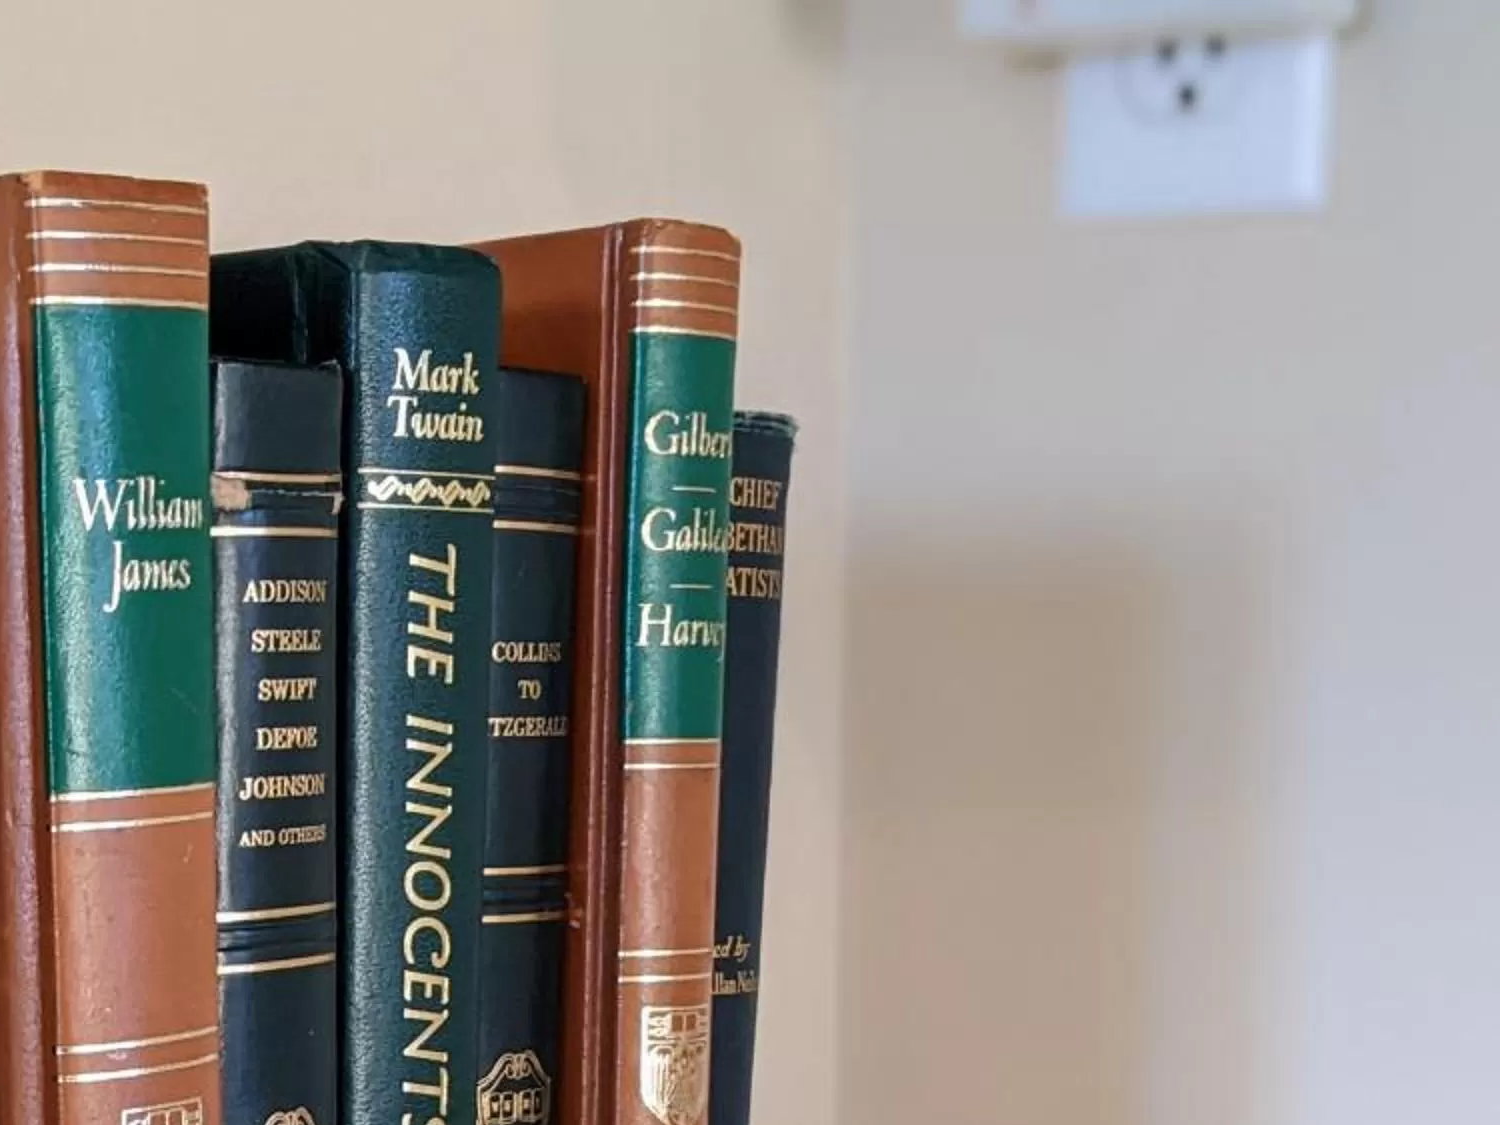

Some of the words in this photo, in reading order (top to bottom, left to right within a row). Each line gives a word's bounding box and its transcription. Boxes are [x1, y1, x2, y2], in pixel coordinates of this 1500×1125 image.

[392, 347, 480, 395] Mark
[386, 395, 484, 442] Twain
[643, 409, 732, 459] Gilber
[72, 476, 203, 531] William
[729, 476, 781, 511] CHIEF
[102, 540, 192, 613] James
[243, 579, 328, 604] ADDISON
[406, 543, 458, 685] THE
[635, 603, 725, 648] Harv
[251, 627, 322, 653] STEELE
[257, 677, 317, 702] SWIFT
[517, 679, 542, 700] TO
[256, 726, 317, 750] DEFOE
[239, 773, 326, 801] JOHNSON
[238, 829, 276, 848] AND
[277, 824, 327, 846] OTHERS
